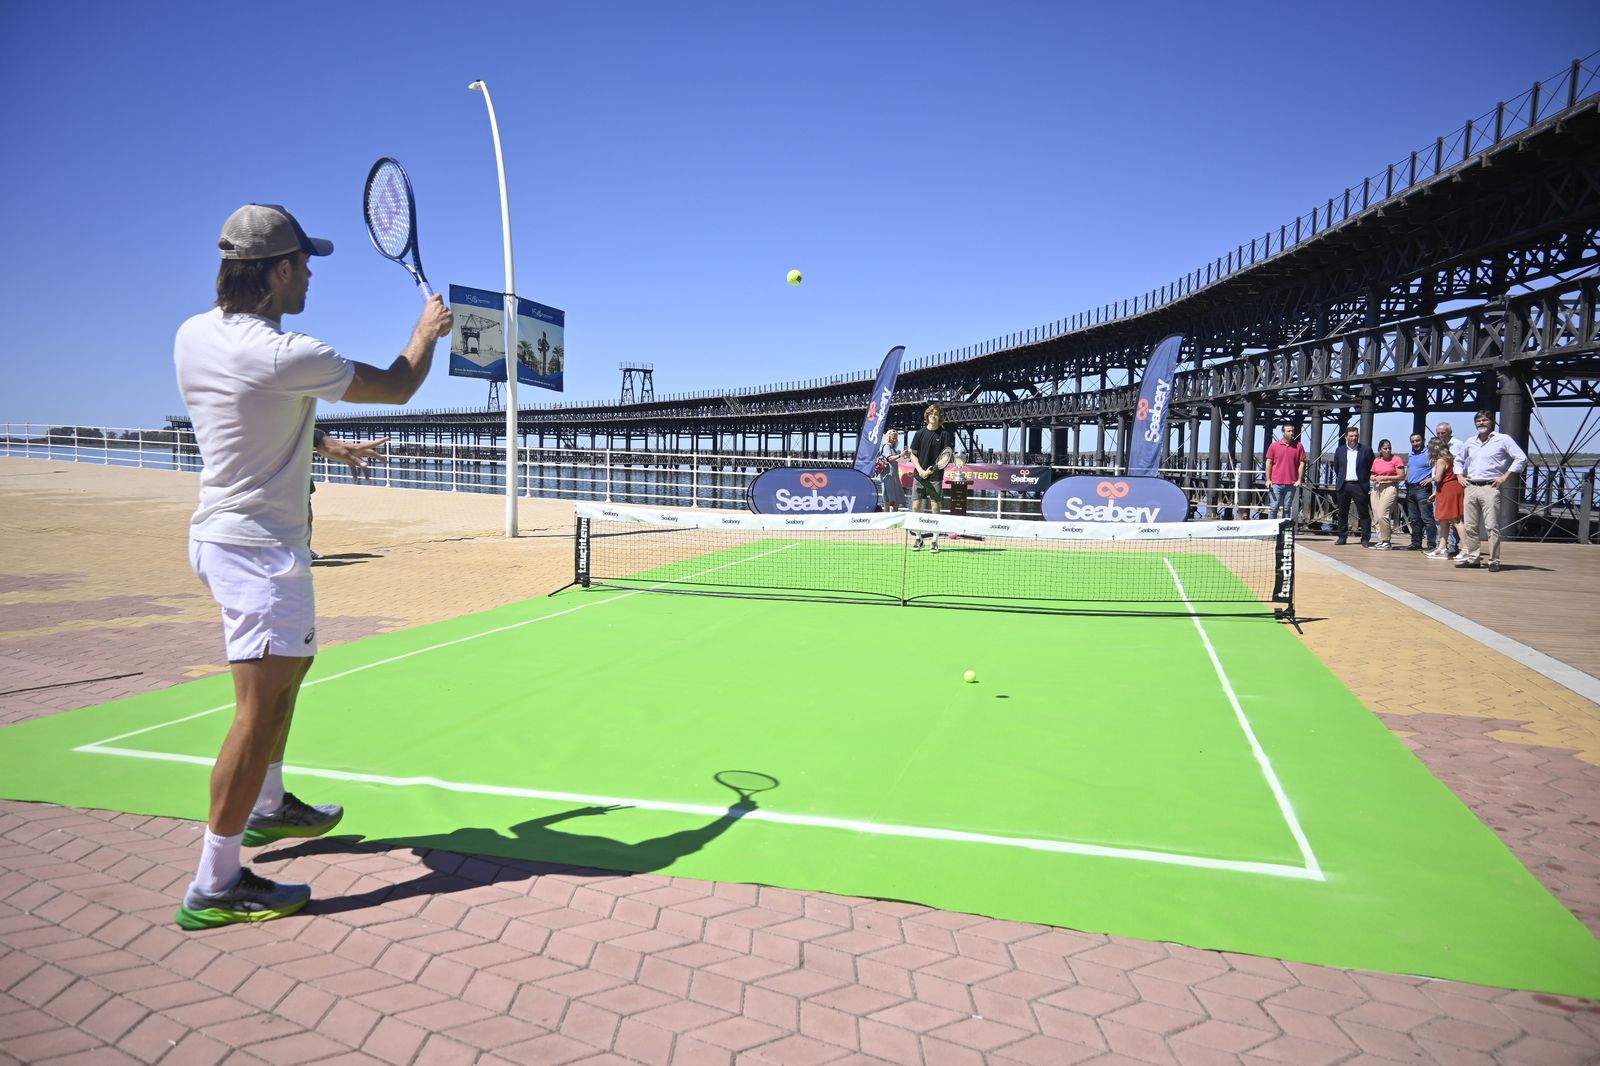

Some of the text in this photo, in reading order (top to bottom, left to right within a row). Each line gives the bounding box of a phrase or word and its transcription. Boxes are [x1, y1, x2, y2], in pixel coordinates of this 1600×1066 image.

[868, 386, 892, 444] Seabery
[1144, 378, 1170, 443] Seabery
[972, 472, 999, 481] TENIS
[1010, 474, 1040, 485] Seabery
[775, 488, 856, 514] Seabery
[1064, 497, 1161, 523] Seabery
[918, 516, 939, 525] Seabery
[1062, 525, 1084, 533] Seabery
